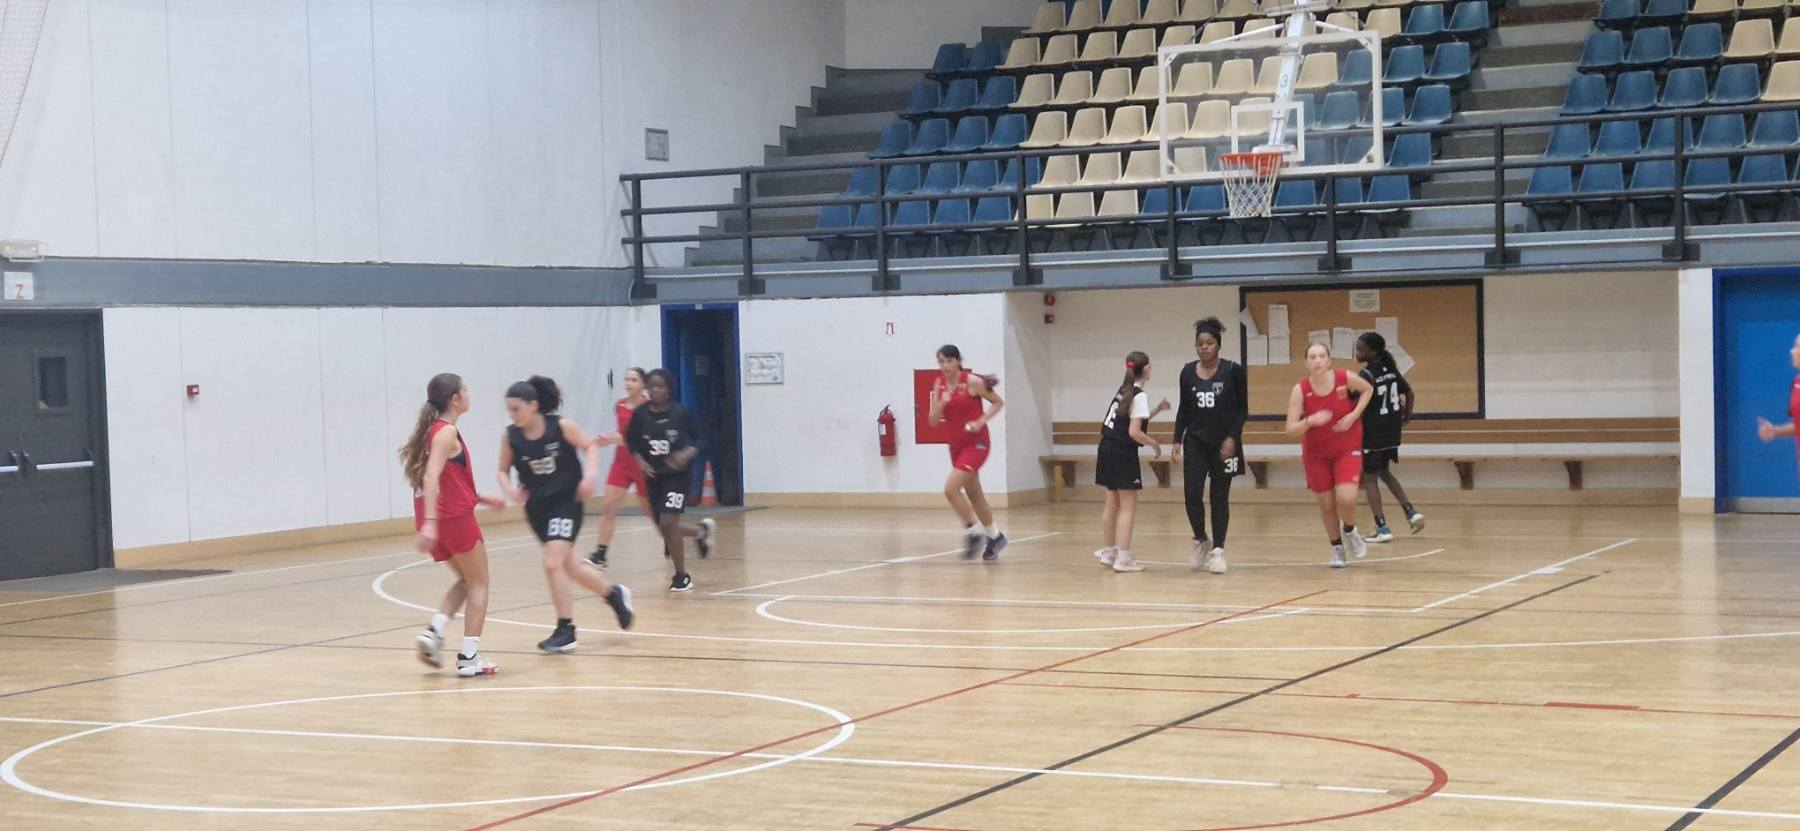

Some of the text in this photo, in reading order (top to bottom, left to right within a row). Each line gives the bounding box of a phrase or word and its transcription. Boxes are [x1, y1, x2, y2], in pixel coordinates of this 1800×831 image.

[1197, 392, 1215, 408] 36
[1377, 381, 1400, 415] 74
[648, 439, 670, 455] 39
[665, 492, 684, 508] 39
